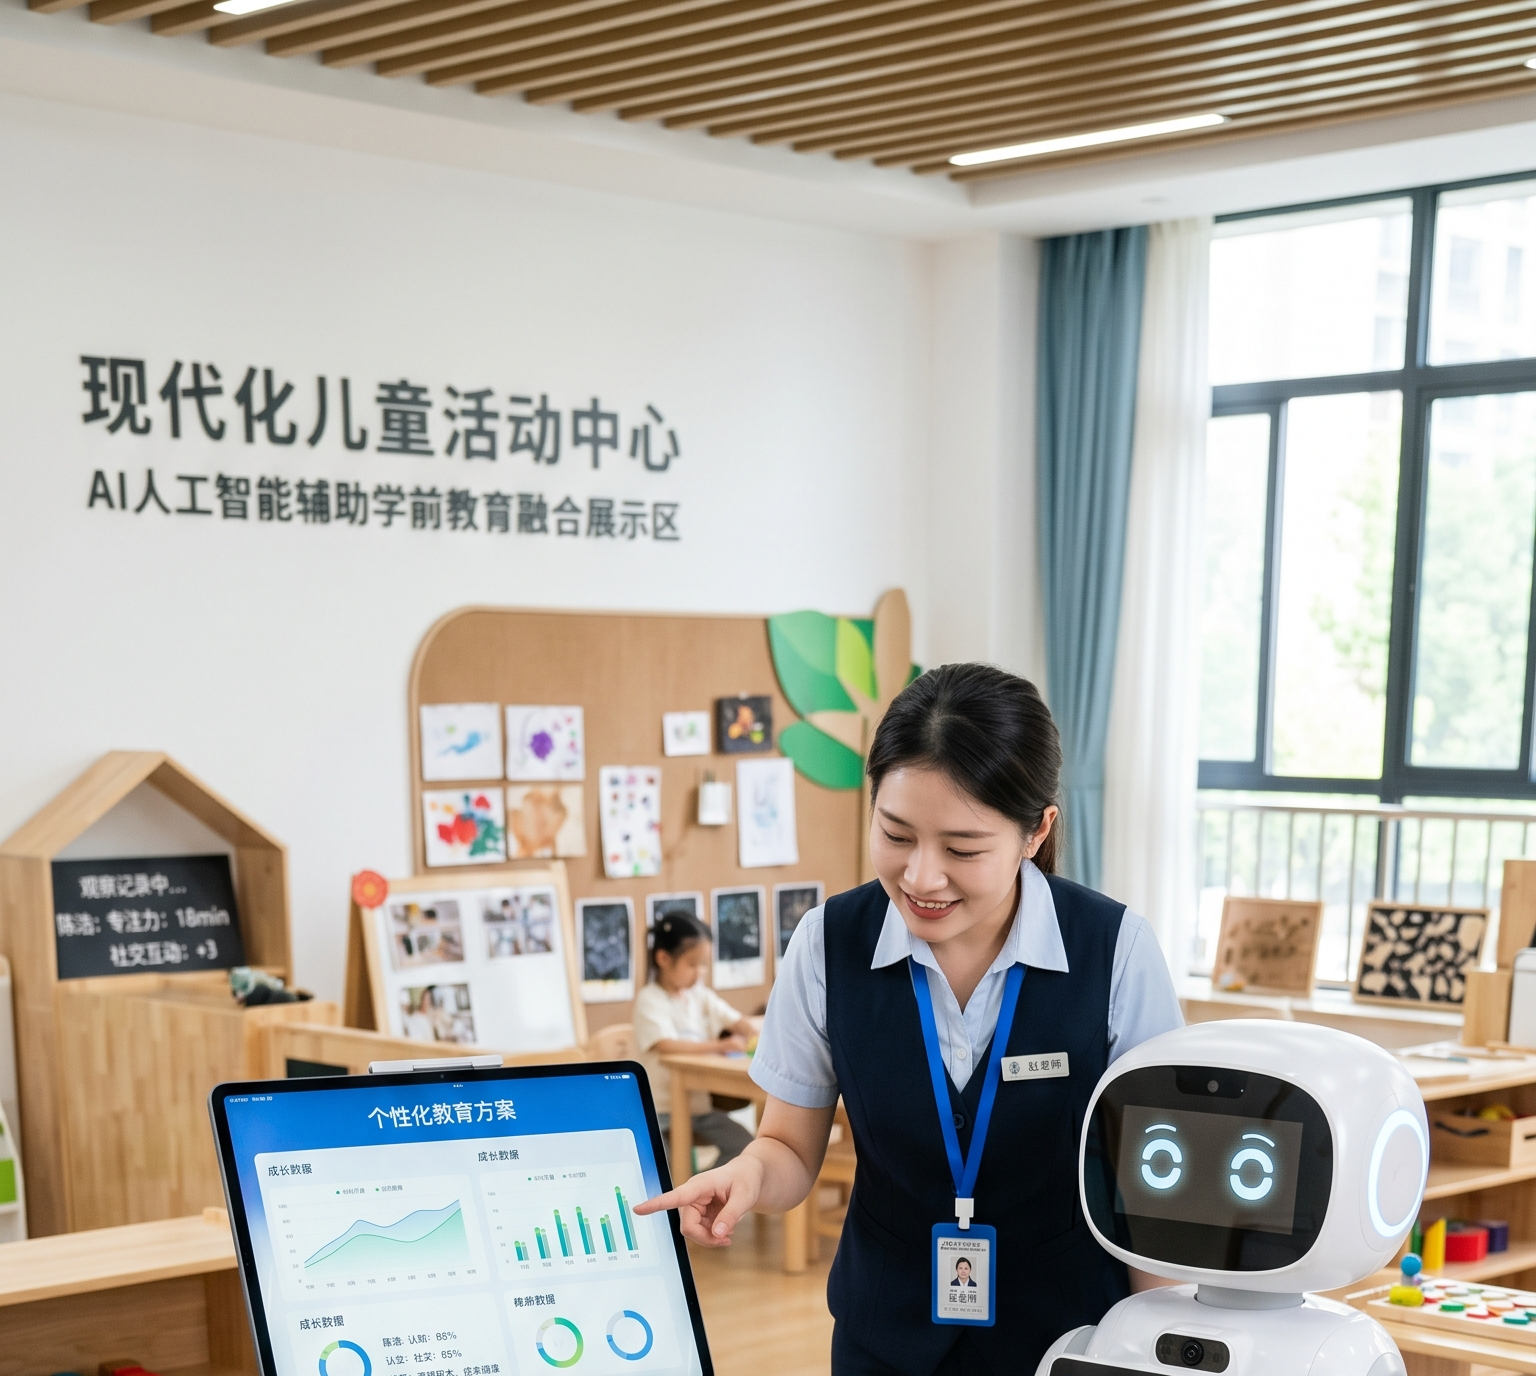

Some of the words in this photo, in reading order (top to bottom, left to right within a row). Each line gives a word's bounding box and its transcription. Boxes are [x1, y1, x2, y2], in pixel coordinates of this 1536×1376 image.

[80, 355, 680, 472] 现代化儿童活动中心
[87, 468, 680, 541] AI人工智能辅助学前教育融合展示区
[368, 1099, 517, 1129] 个性化教育方案
